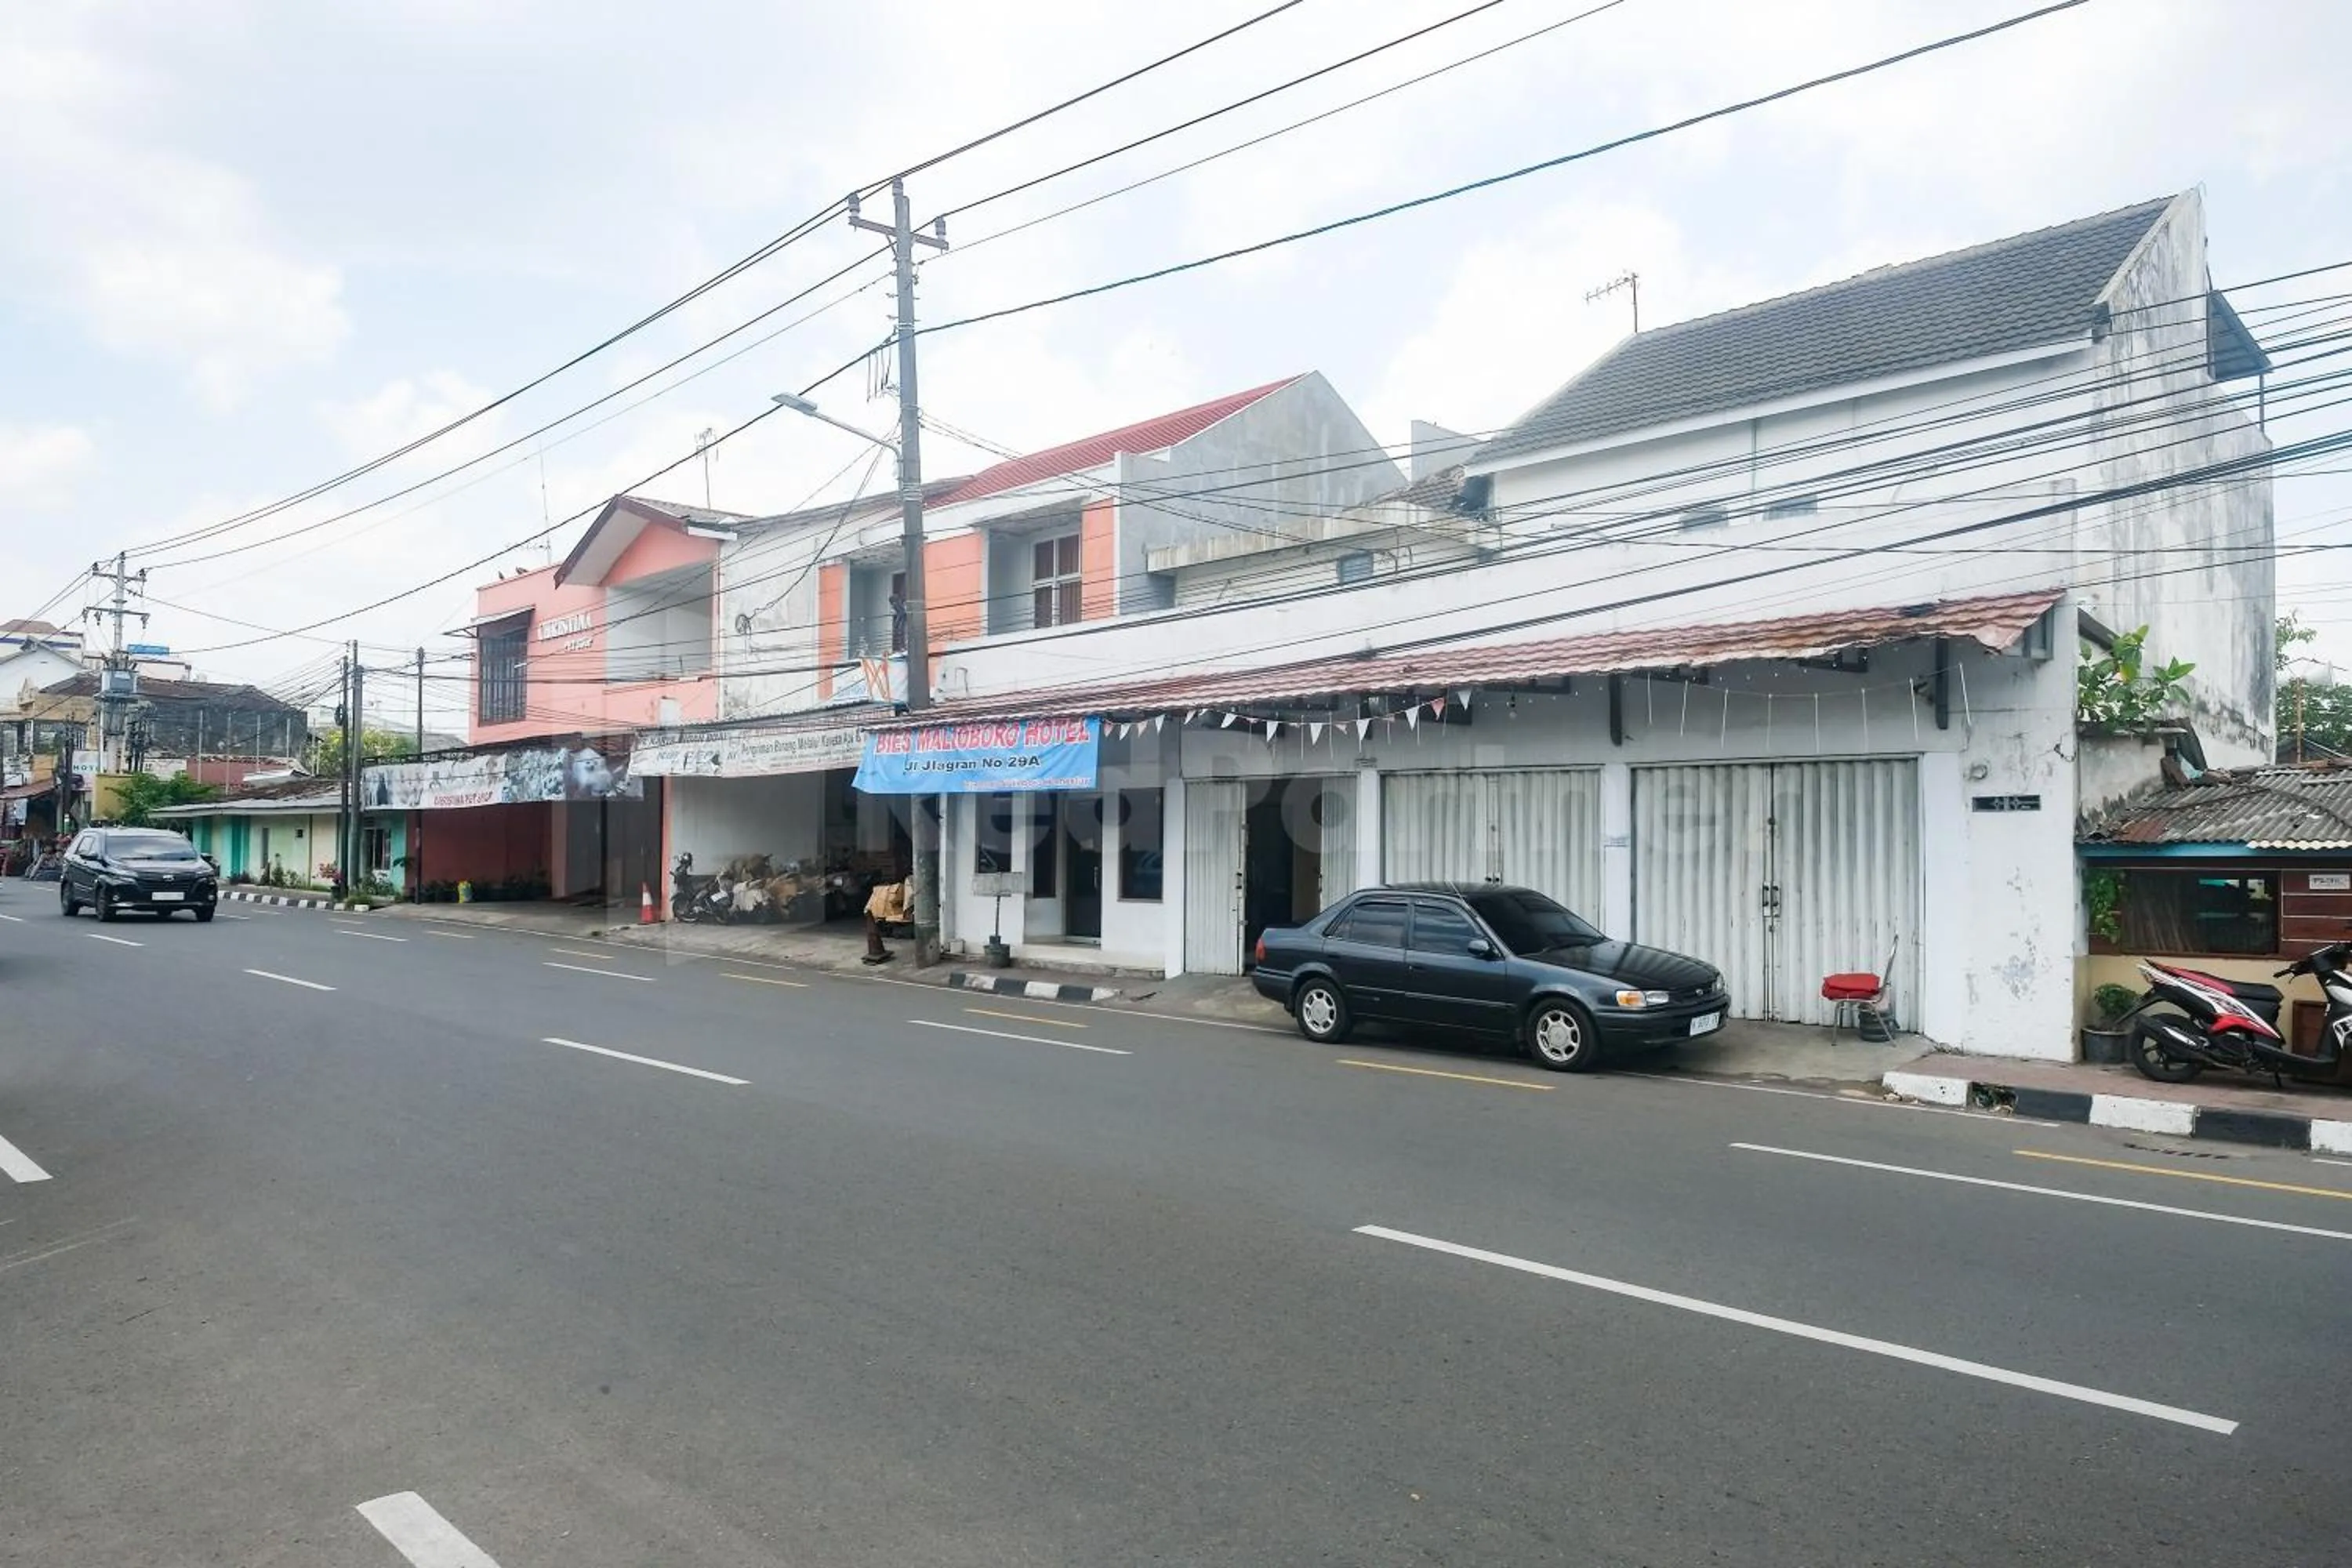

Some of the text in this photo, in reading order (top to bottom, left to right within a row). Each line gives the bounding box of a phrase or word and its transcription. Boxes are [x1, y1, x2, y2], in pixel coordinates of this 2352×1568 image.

[916, 722, 1019, 753] MALIOBORO
[1024, 717, 1089, 746] HOTEL
[982, 758, 1002, 768] No
